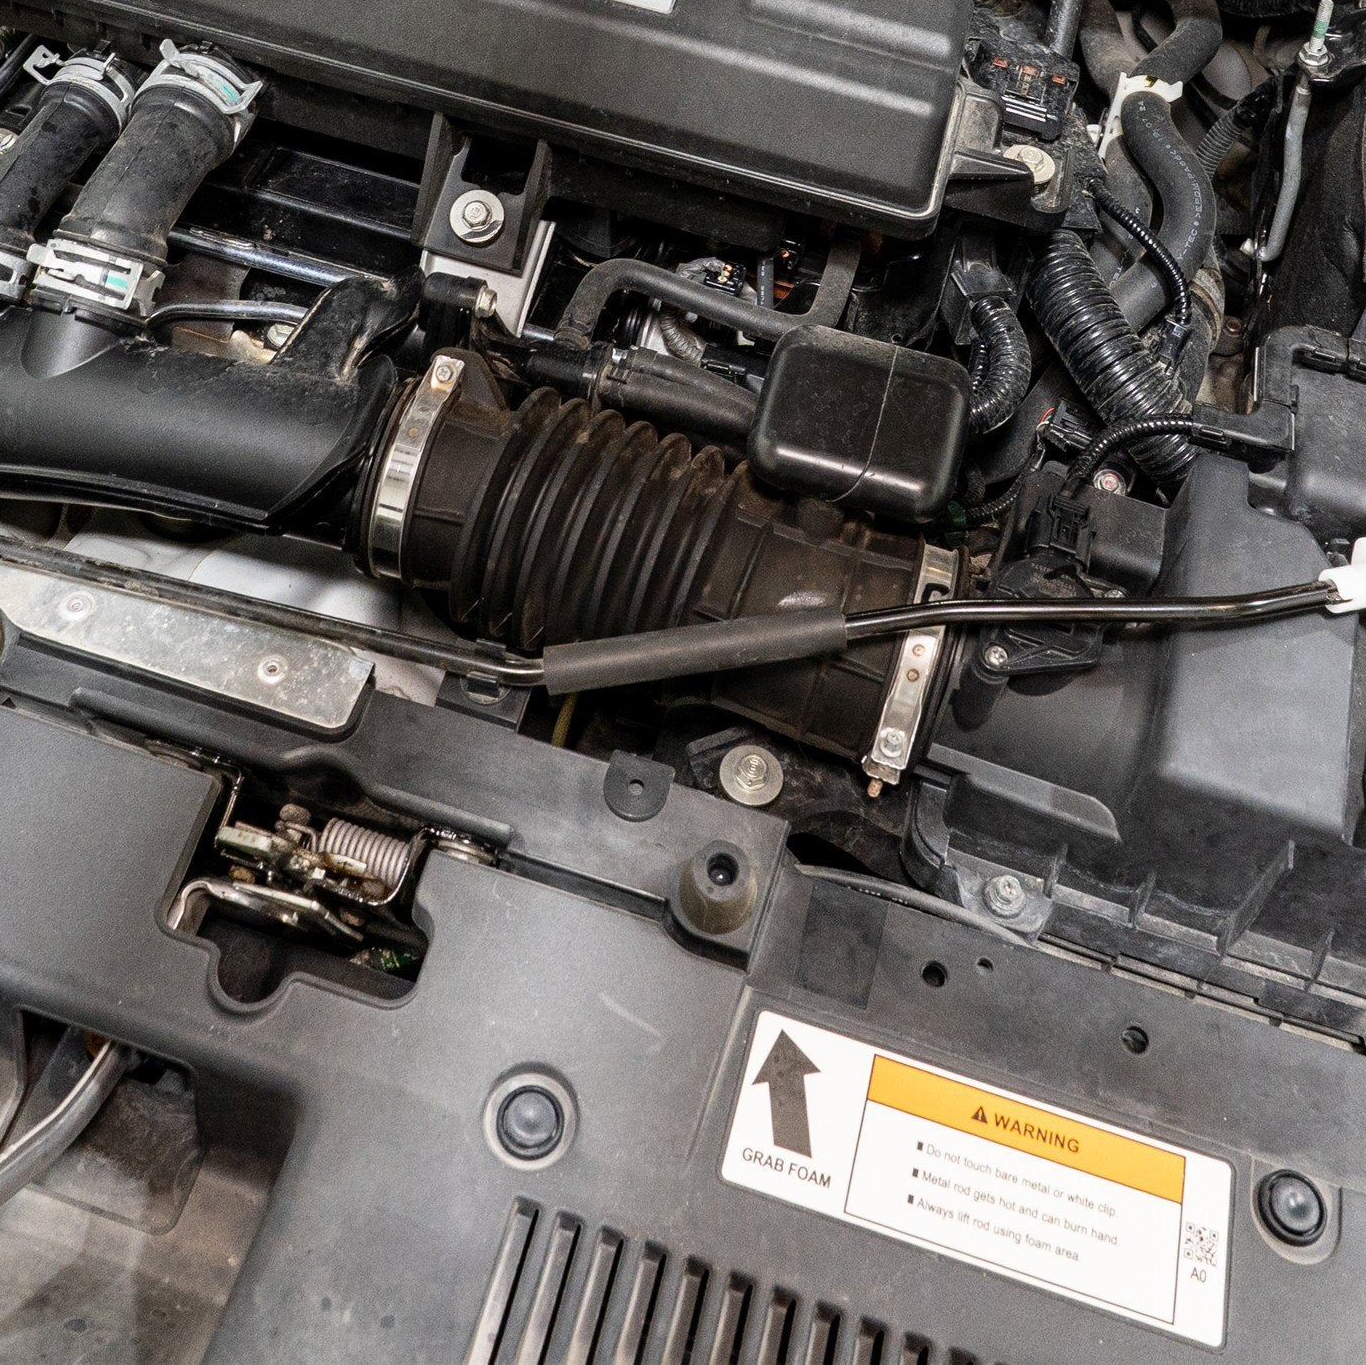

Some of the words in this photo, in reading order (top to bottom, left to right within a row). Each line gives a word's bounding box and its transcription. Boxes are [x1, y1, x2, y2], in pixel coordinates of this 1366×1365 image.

[994, 1113, 1080, 1153] WARNING
[742, 1147, 785, 1173] GRAB
[788, 1163, 831, 1189] FOAM
[926, 1143, 941, 1158] Do
[944, 1152, 961, 1164] not
[964, 1158, 992, 1175] touch
[995, 1168, 1018, 1184] bare
[1022, 1178, 1051, 1195] metal
[1053, 1189, 1064, 1198] or
[1067, 1193, 1094, 1210] white
[917, 1197, 954, 1219] Always
[957, 1210, 970, 1225] lift
[973, 1218, 990, 1232] rod
[993, 1225, 1022, 1245] using
[1025, 1233, 1052, 1252] foam
[922, 1170, 951, 1189] Metal
[954, 1183, 971, 1196] rod
[973, 1190, 996, 1206] gets
[999, 1197, 1016, 1211] hot
[1018, 1205, 1038, 1219] and
[1041, 1213, 1061, 1226] can
[1064, 1218, 1088, 1235] burn
